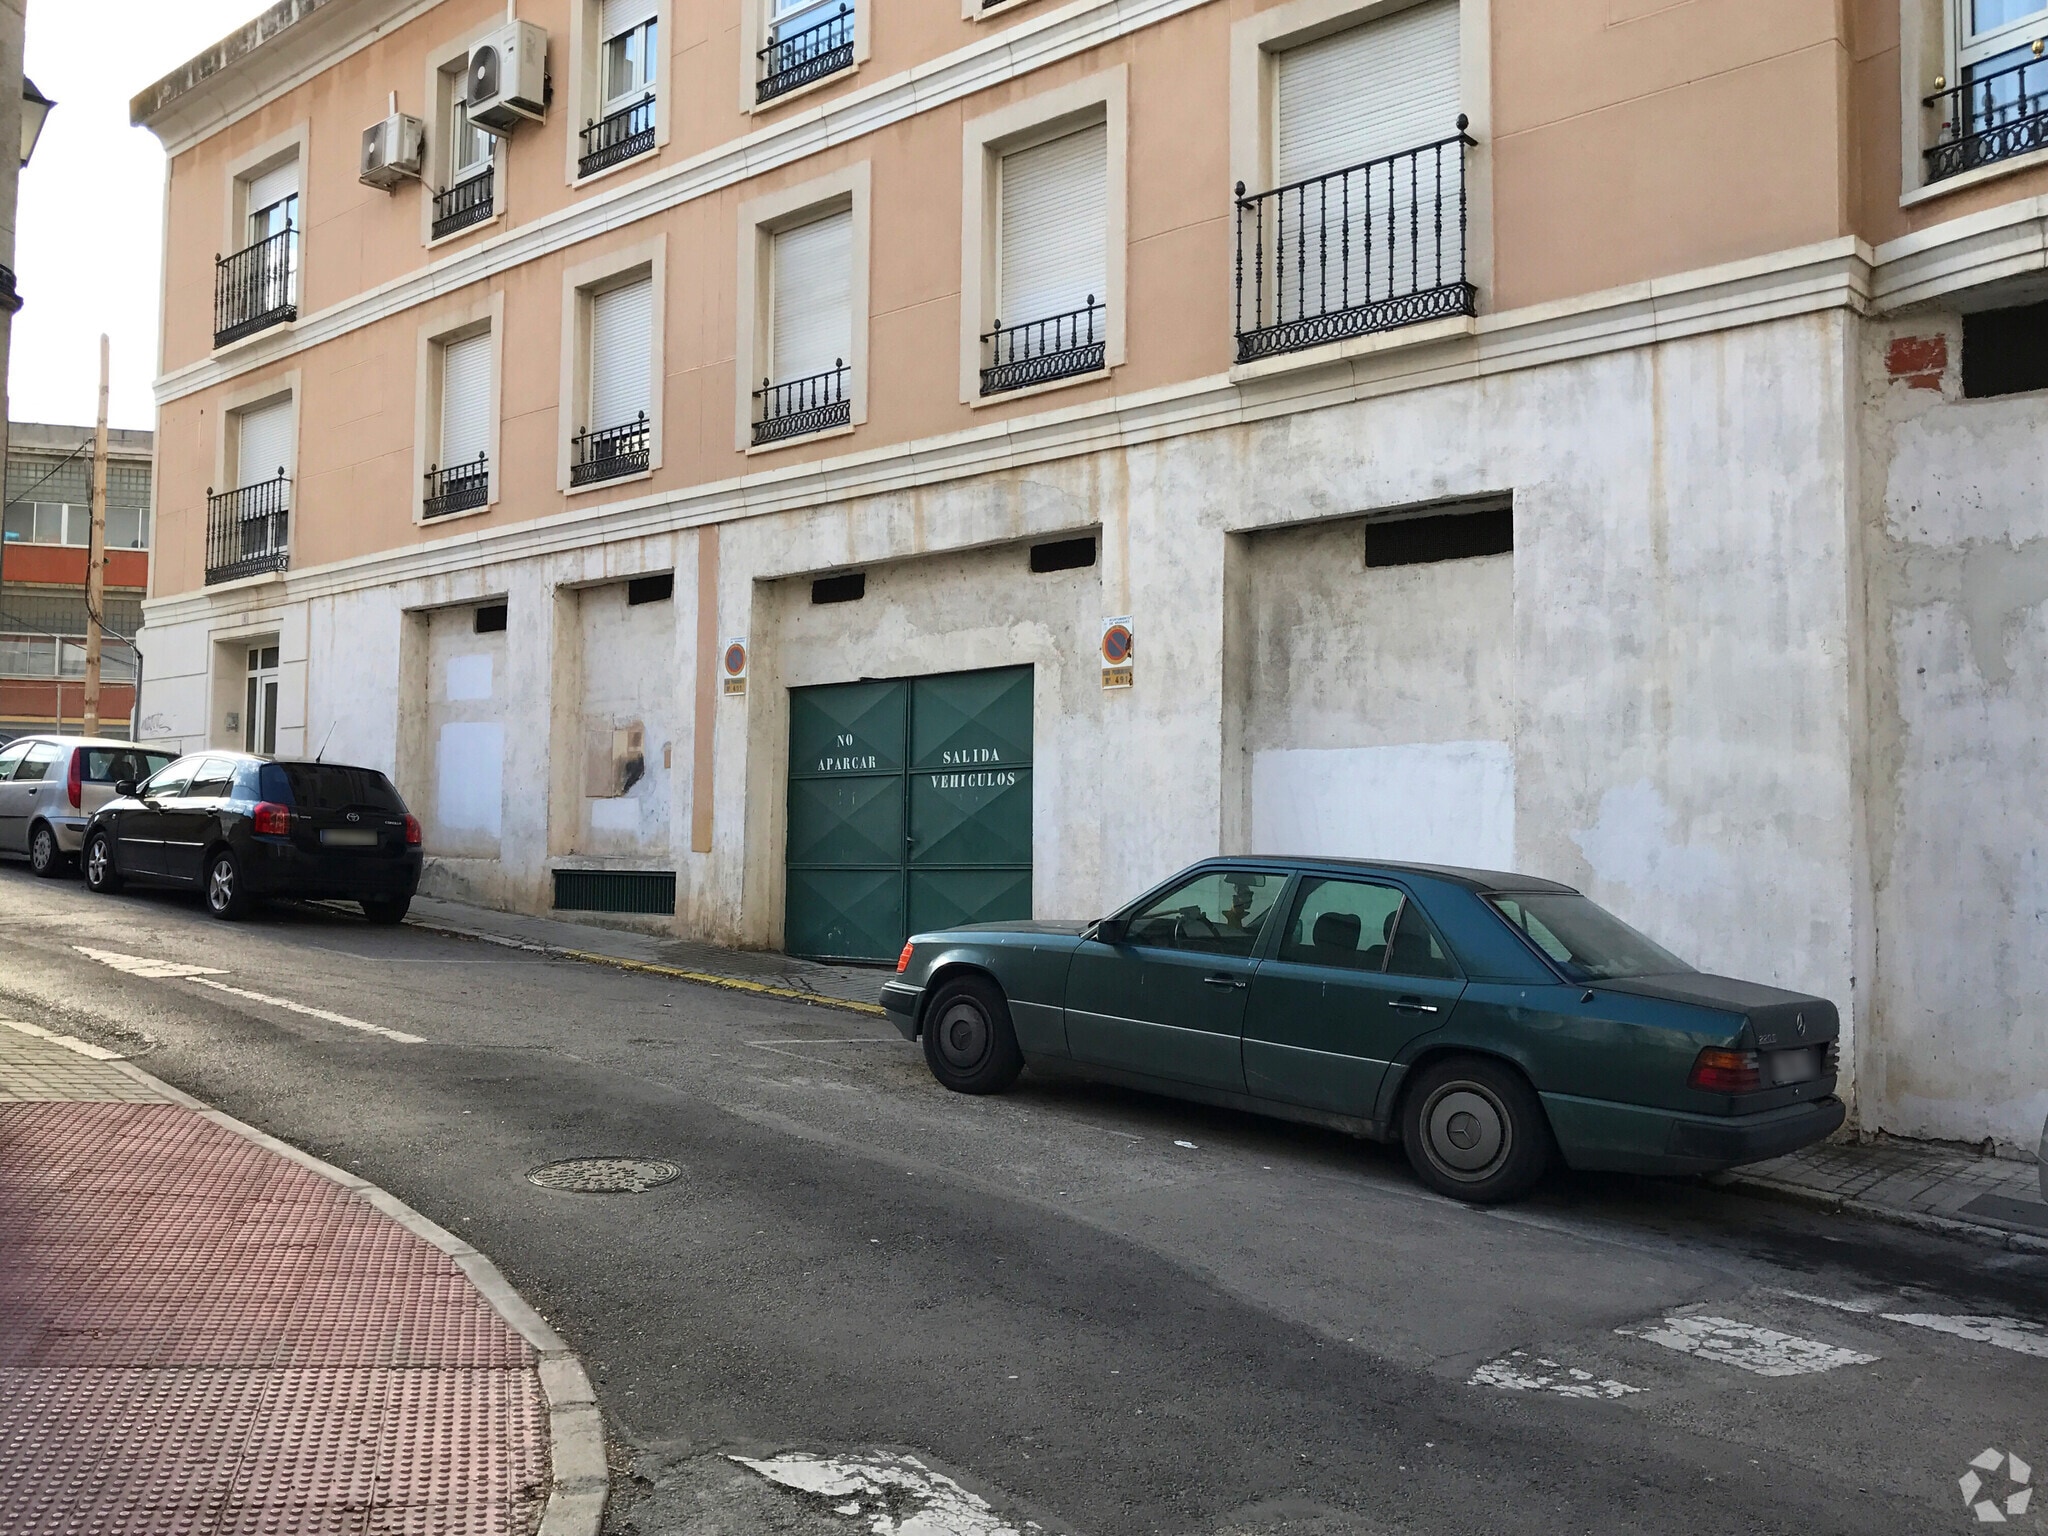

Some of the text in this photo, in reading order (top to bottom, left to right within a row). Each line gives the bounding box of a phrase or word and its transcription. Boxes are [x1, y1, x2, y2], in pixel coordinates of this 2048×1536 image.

[837, 733, 853, 748] NO
[817, 755, 876, 771] APARCAR
[942, 748, 1000, 765] SALIDA
[931, 771, 1016, 789] VEHICULOS
